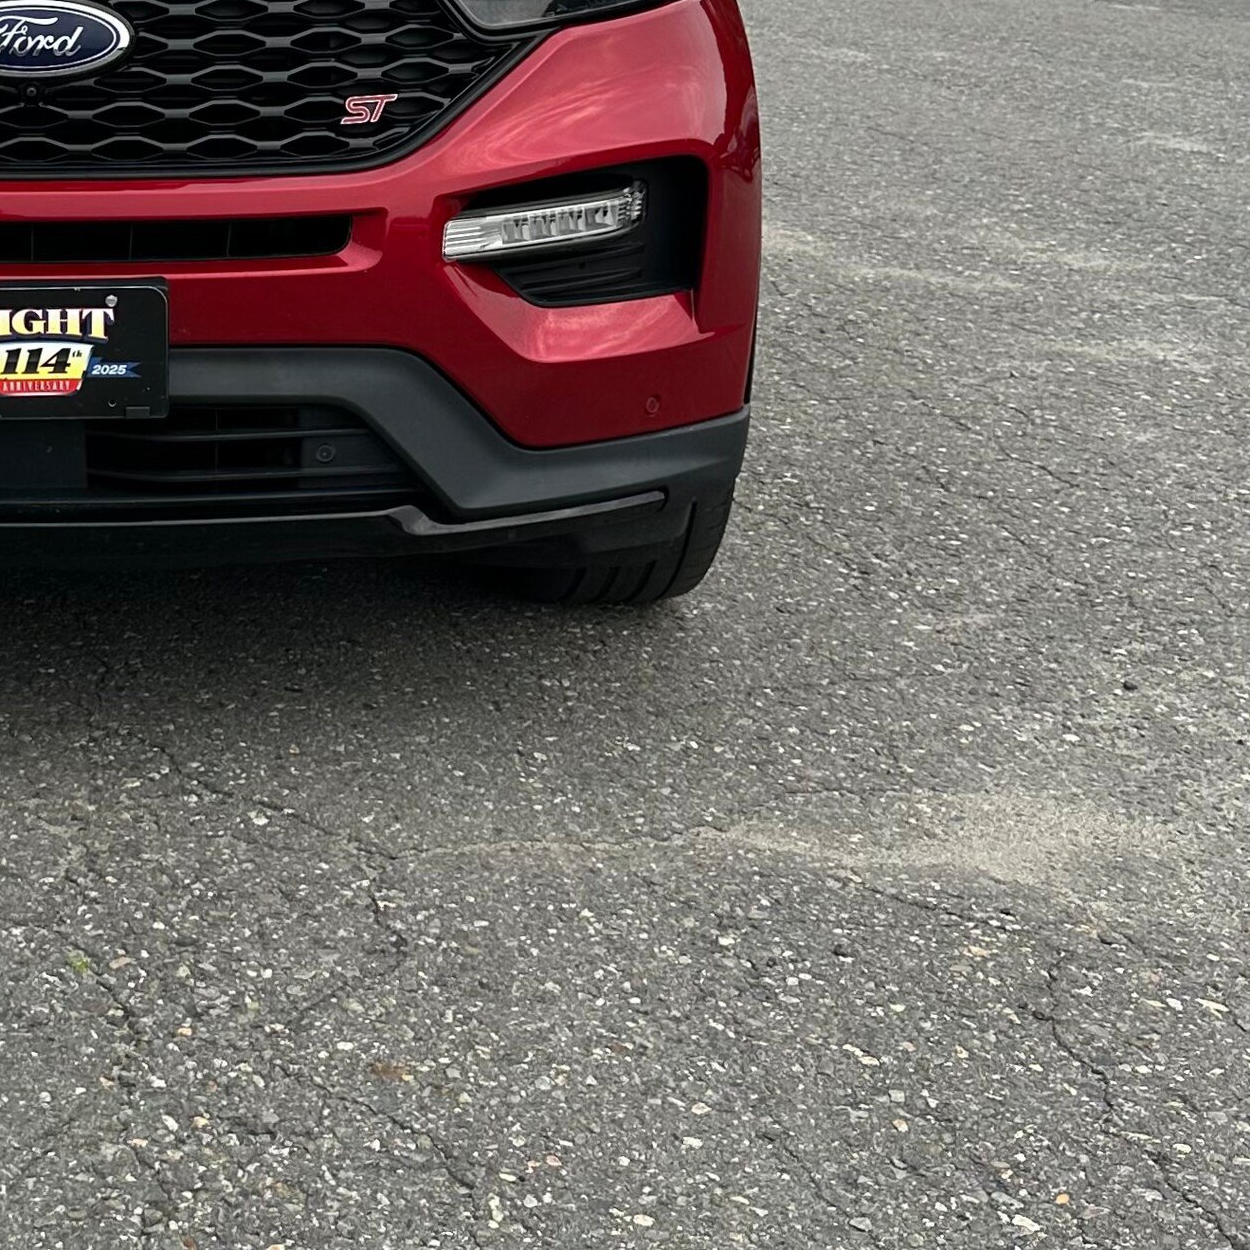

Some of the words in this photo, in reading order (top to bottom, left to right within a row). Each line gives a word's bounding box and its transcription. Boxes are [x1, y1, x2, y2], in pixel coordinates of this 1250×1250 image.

[340, 94, 398, 124] ST
[91, 364, 128, 376] 2025
[2, 380, 71, 392] ANNIVERSARY
